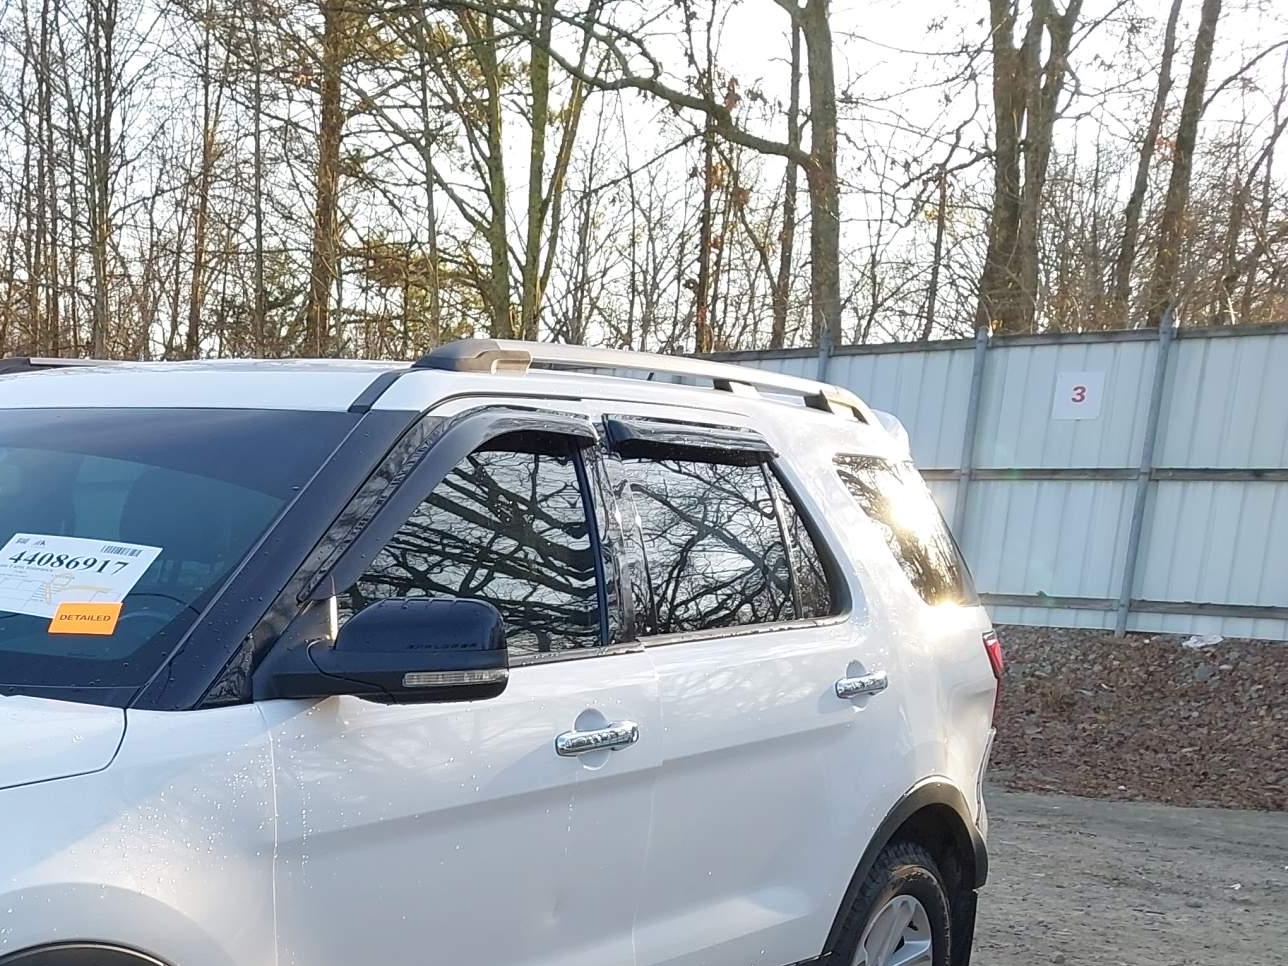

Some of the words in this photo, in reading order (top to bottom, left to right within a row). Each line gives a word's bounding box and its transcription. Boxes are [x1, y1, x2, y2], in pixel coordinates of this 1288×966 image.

[1071, 385, 1087, 403] 3
[9, 550, 129, 575] 44086917
[59, 614, 112, 622] DETAILED
